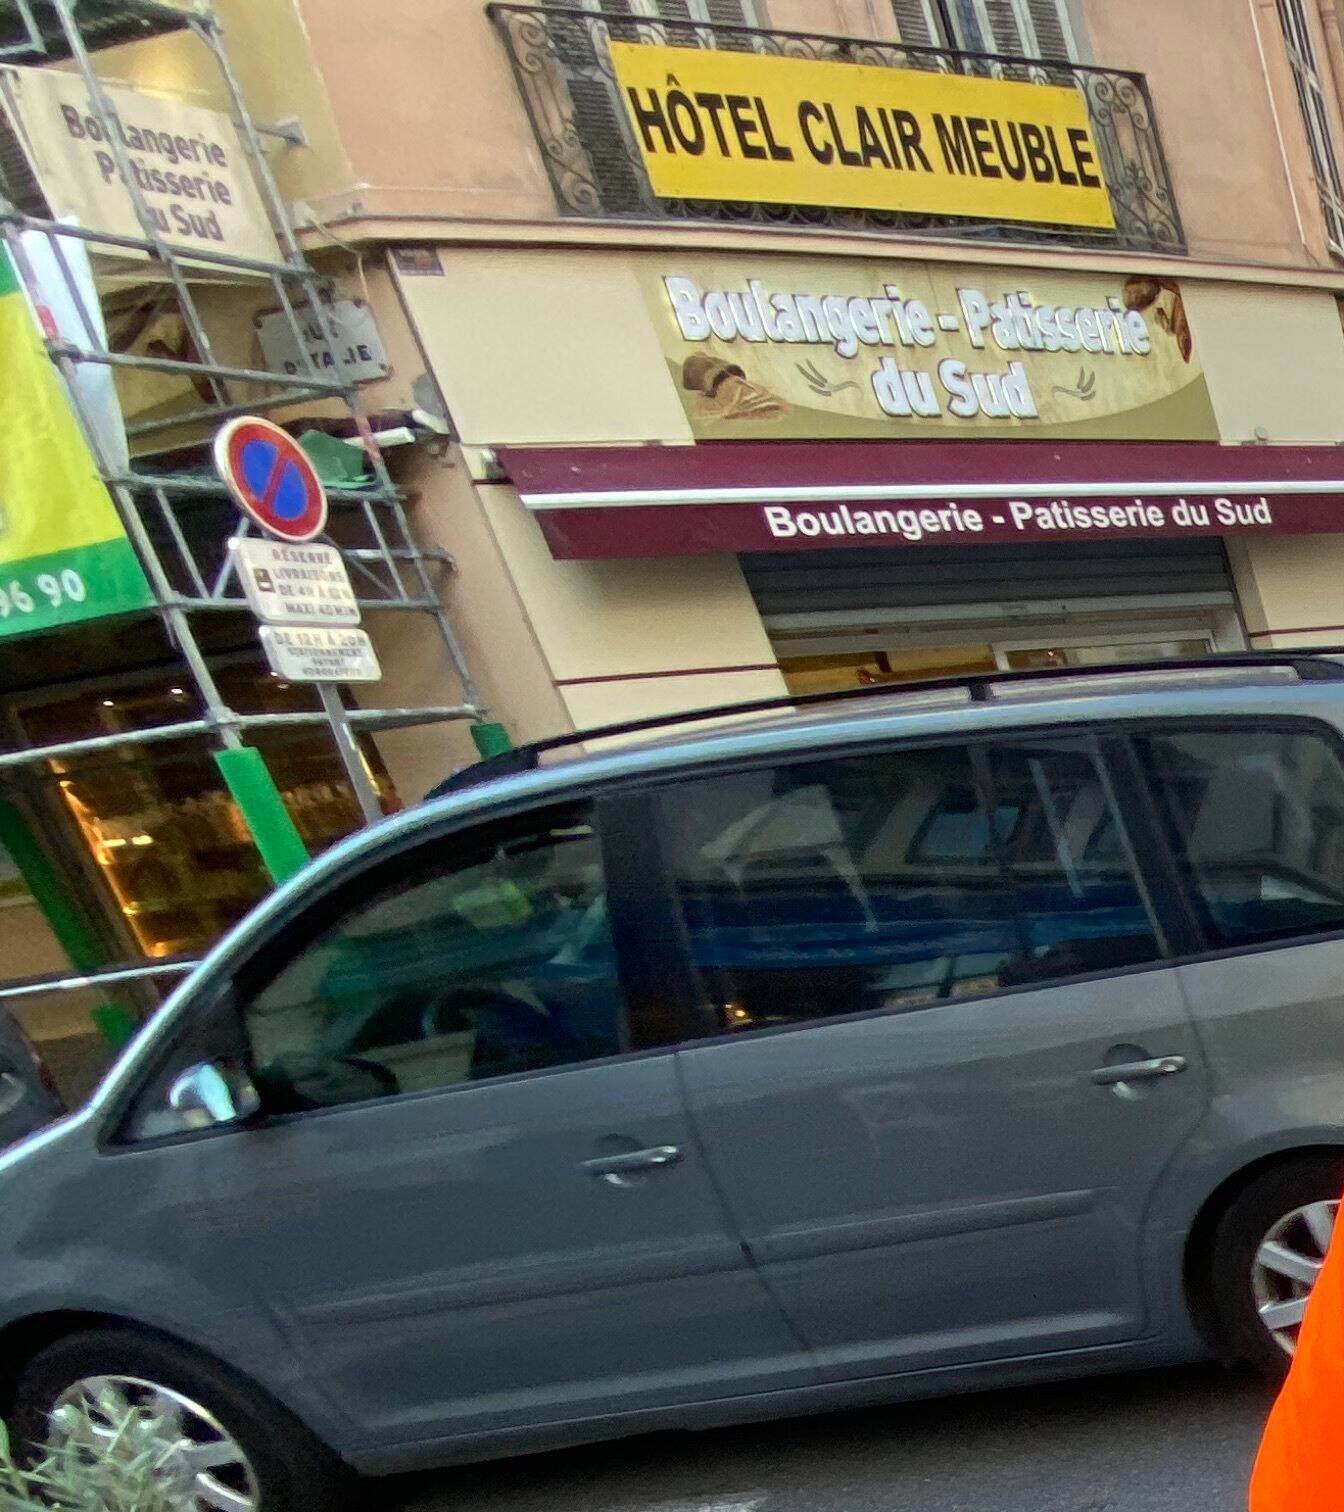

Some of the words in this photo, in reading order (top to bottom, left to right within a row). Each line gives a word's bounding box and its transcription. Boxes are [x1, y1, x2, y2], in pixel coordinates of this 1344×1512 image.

[61, 103, 227, 167] Bolangerie
[626, 73, 794, 162] HÔTEL
[798, 100, 933, 173] CLAIR
[932, 113, 1101, 189] MEUBLE
[95, 150, 232, 205] Ptisserie
[170, 203, 225, 241] Sud
[662, 275, 936, 359] Boulangerie
[956, 287, 1152, 355] Patisserie
[871, 356, 943, 417] du
[938, 358, 1039, 419] Sud
[763, 501, 984, 541] Boulangerie
[1011, 499, 1166, 532] Patisserie
[1172, 498, 1210, 527] du
[1216, 497, 1273, 526] Sud
[37, 568, 86, 608] 90
